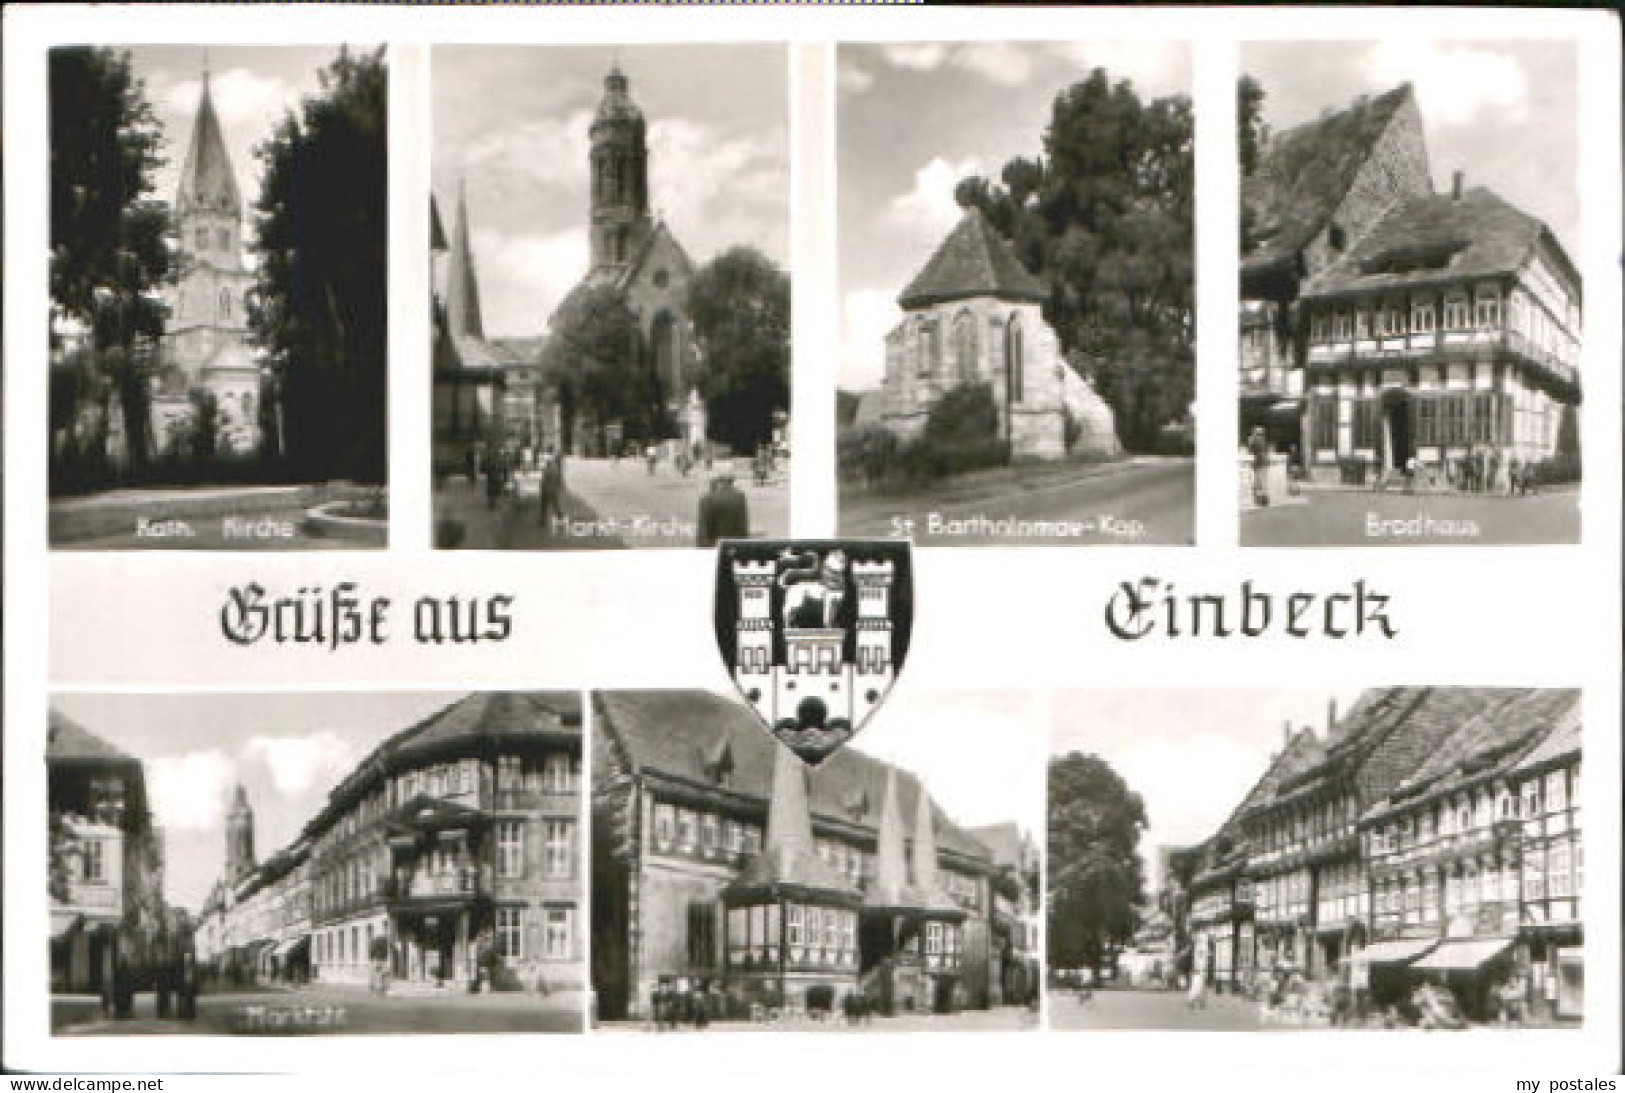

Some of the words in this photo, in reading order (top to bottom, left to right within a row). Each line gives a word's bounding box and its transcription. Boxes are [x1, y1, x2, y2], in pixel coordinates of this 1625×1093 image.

[222, 515, 296, 538] Kirche
[1364, 511, 1480, 537] Brodhaus
[219, 580, 391, 652] Grüße
[413, 593, 515, 645] aus
[1104, 576, 1399, 640] Einbeck
